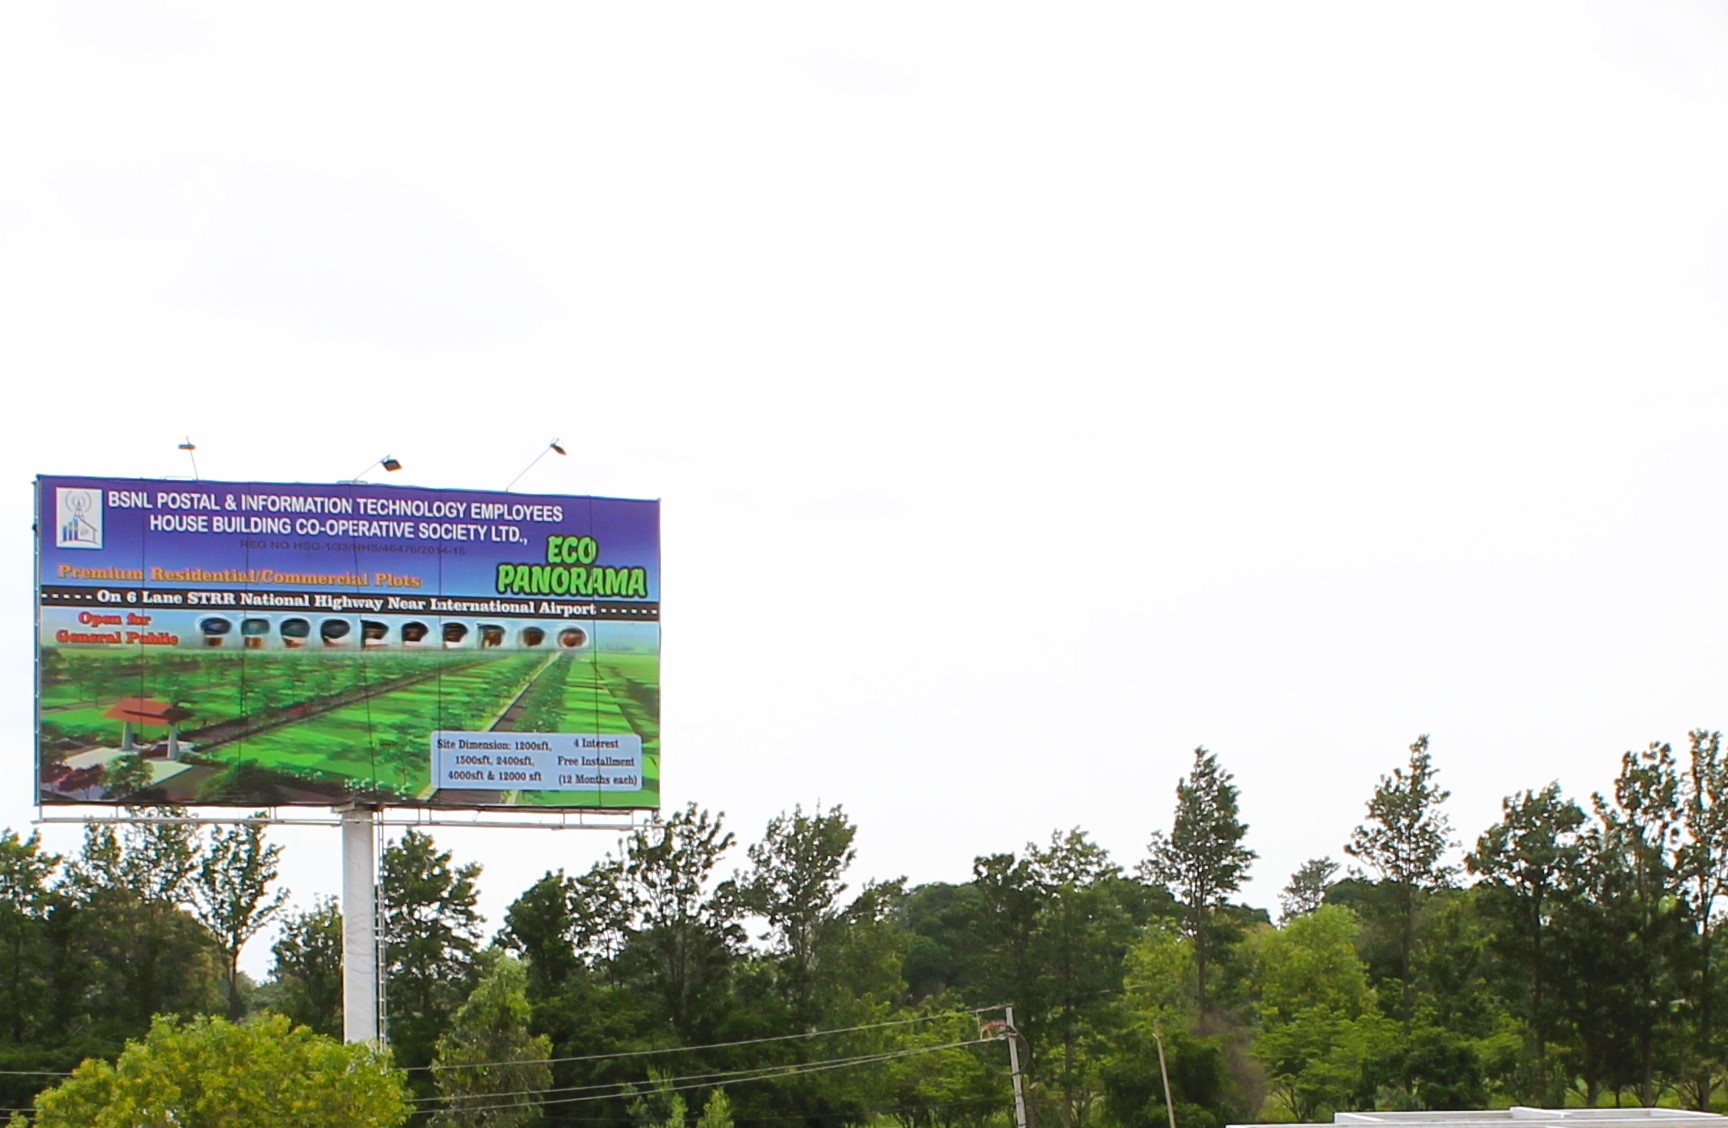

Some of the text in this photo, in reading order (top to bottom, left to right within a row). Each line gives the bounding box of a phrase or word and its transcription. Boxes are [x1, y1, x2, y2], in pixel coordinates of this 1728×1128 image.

[108, 490, 564, 523] BSNL POSTAL & INFORMATION TECHNOLOGY EMPLOYEES
[150, 514, 208, 533] HOUSE
[212, 515, 291, 535] BUILDING
[295, 517, 415, 540] CO-OPERATIVE
[418, 522, 487, 541] SOCIETY
[240, 539, 267, 550] REG
[271, 540, 290, 550] NO
[547, 535, 598, 565] ECO
[58, 564, 422, 588] Premium Residential/Commercial Plots
[496, 564, 648, 597] PANORAMA
[97, 589, 597, 617] On 6 Lane STRR National Highway Near International Airport
[79, 612, 152, 628] Open for
[56, 630, 179, 646] General Public
[437, 738, 456, 749] Site
[458, 739, 512, 751] Dimension:
[582, 739, 620, 749] Interest
[557, 755, 636, 767] Free Installment
[487, 771, 496, 781] &
[575, 774, 611, 785] Months
[613, 775, 638, 786] each)
